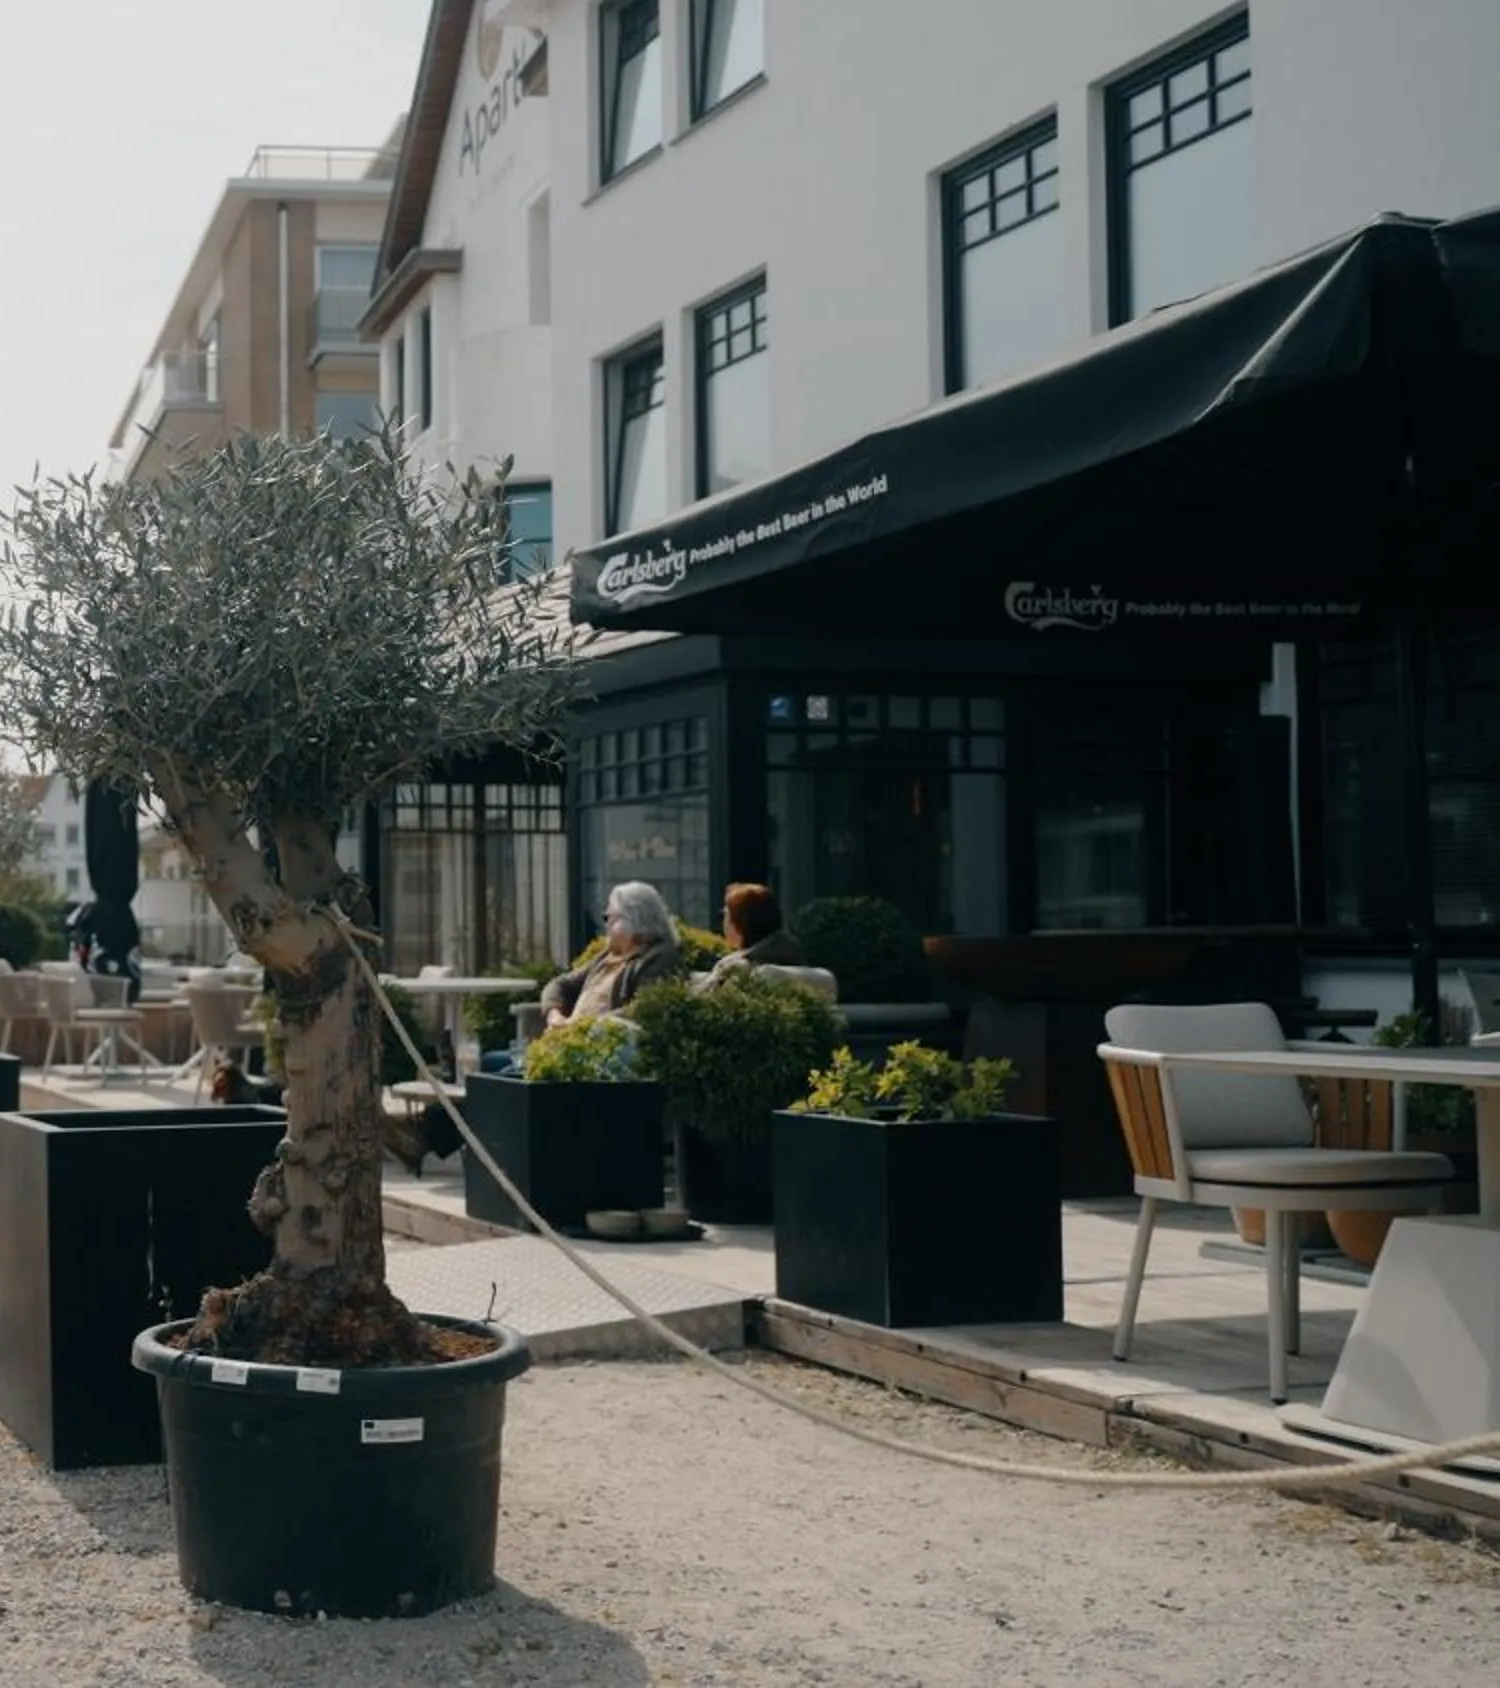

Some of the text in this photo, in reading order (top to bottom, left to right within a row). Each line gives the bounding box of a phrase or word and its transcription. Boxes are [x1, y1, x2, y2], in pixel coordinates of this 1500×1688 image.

[459, 38, 527, 177] Apart
[597, 474, 889, 602] Carlsberg Probably the Best Beer in the World
[1004, 581, 1120, 631] Carlsberg
[1125, 600, 1187, 619] Probably
